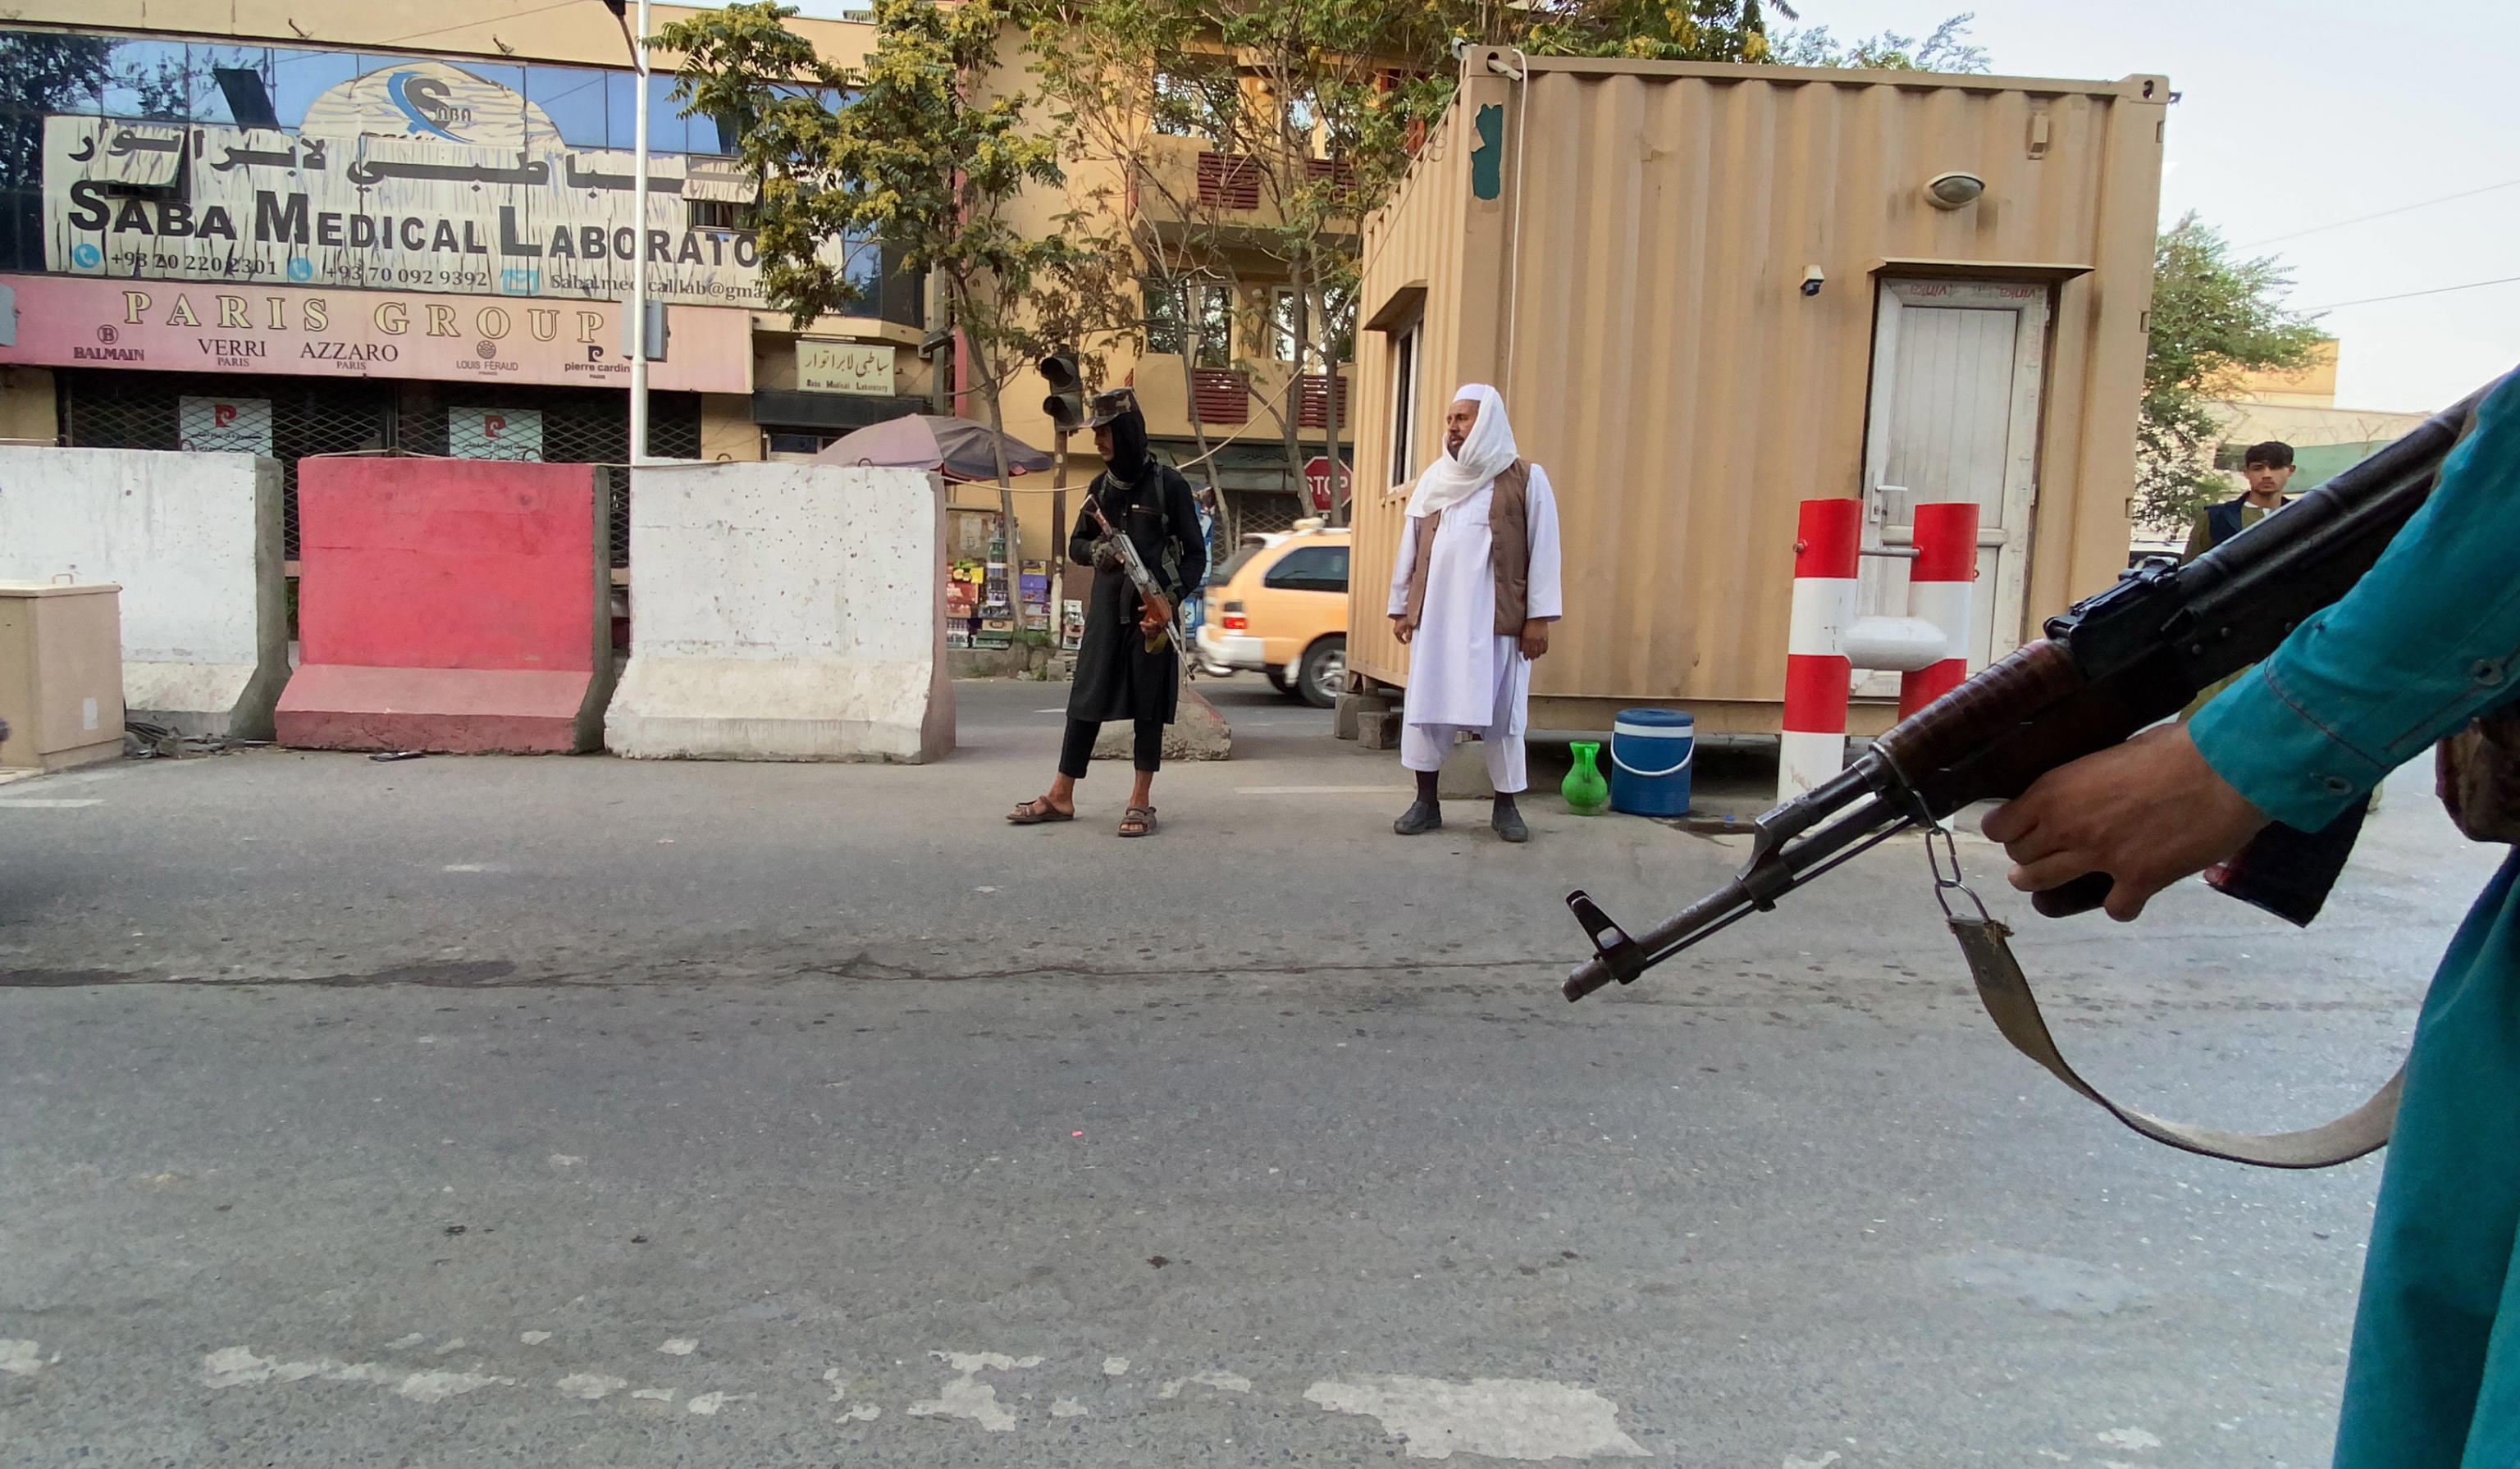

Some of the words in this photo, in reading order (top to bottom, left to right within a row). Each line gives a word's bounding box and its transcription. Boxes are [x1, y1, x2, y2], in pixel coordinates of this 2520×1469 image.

[68, 180, 238, 240] SABA
[255, 189, 487, 254] MEDICAL
[499, 205, 759, 268] LABORATO
[112, 252, 148, 268] +93
[185, 254, 221, 271] 220
[230, 257, 277, 275] 2301
[326, 266, 362, 281] +93
[368, 267, 392, 281] 70
[398, 268, 433, 285] 092
[440, 271, 487, 286] 9392
[123, 291, 329, 332] PARIS
[374, 301, 605, 344] GROUP
[73, 346, 144, 361] BALMAIN
[198, 339, 267, 357] VERRI
[300, 341, 399, 363] AZZARO
[217, 357, 250, 367] PARIS
[336, 361, 367, 370] PARIS
[456, 360, 481, 369] LOUIS
[564, 362, 595, 372] pierre
[597, 363, 631, 373] cardin
